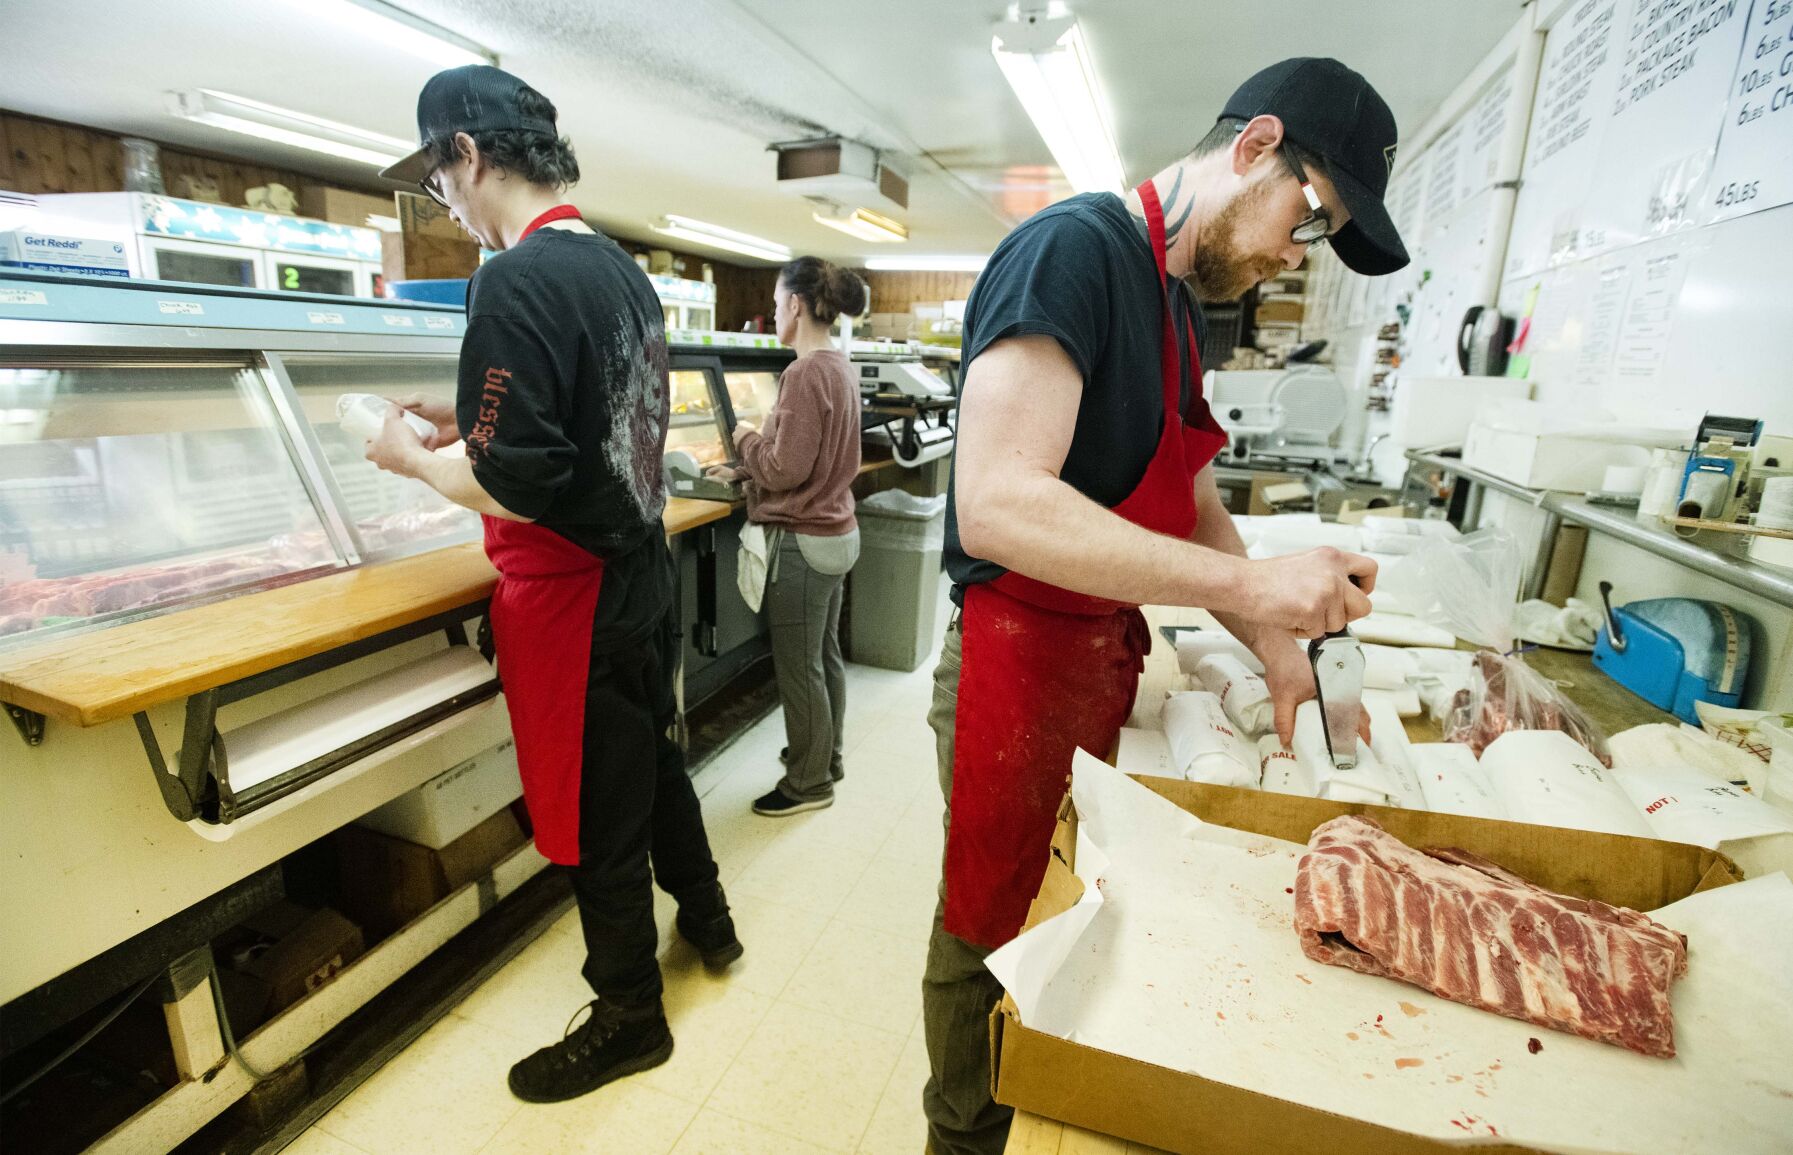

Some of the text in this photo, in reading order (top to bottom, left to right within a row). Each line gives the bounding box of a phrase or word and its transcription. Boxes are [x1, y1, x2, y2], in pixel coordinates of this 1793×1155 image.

[1687, 0, 1737, 46] BACON
[1658, 47, 1700, 88] STEAK
[1715, 180, 1760, 207] 45LBS
[25, 236, 46, 246] Get
[284, 267, 299, 289] 2
[1271, 751, 1298, 761] SALE
[1645, 796, 1670, 815] NOT
